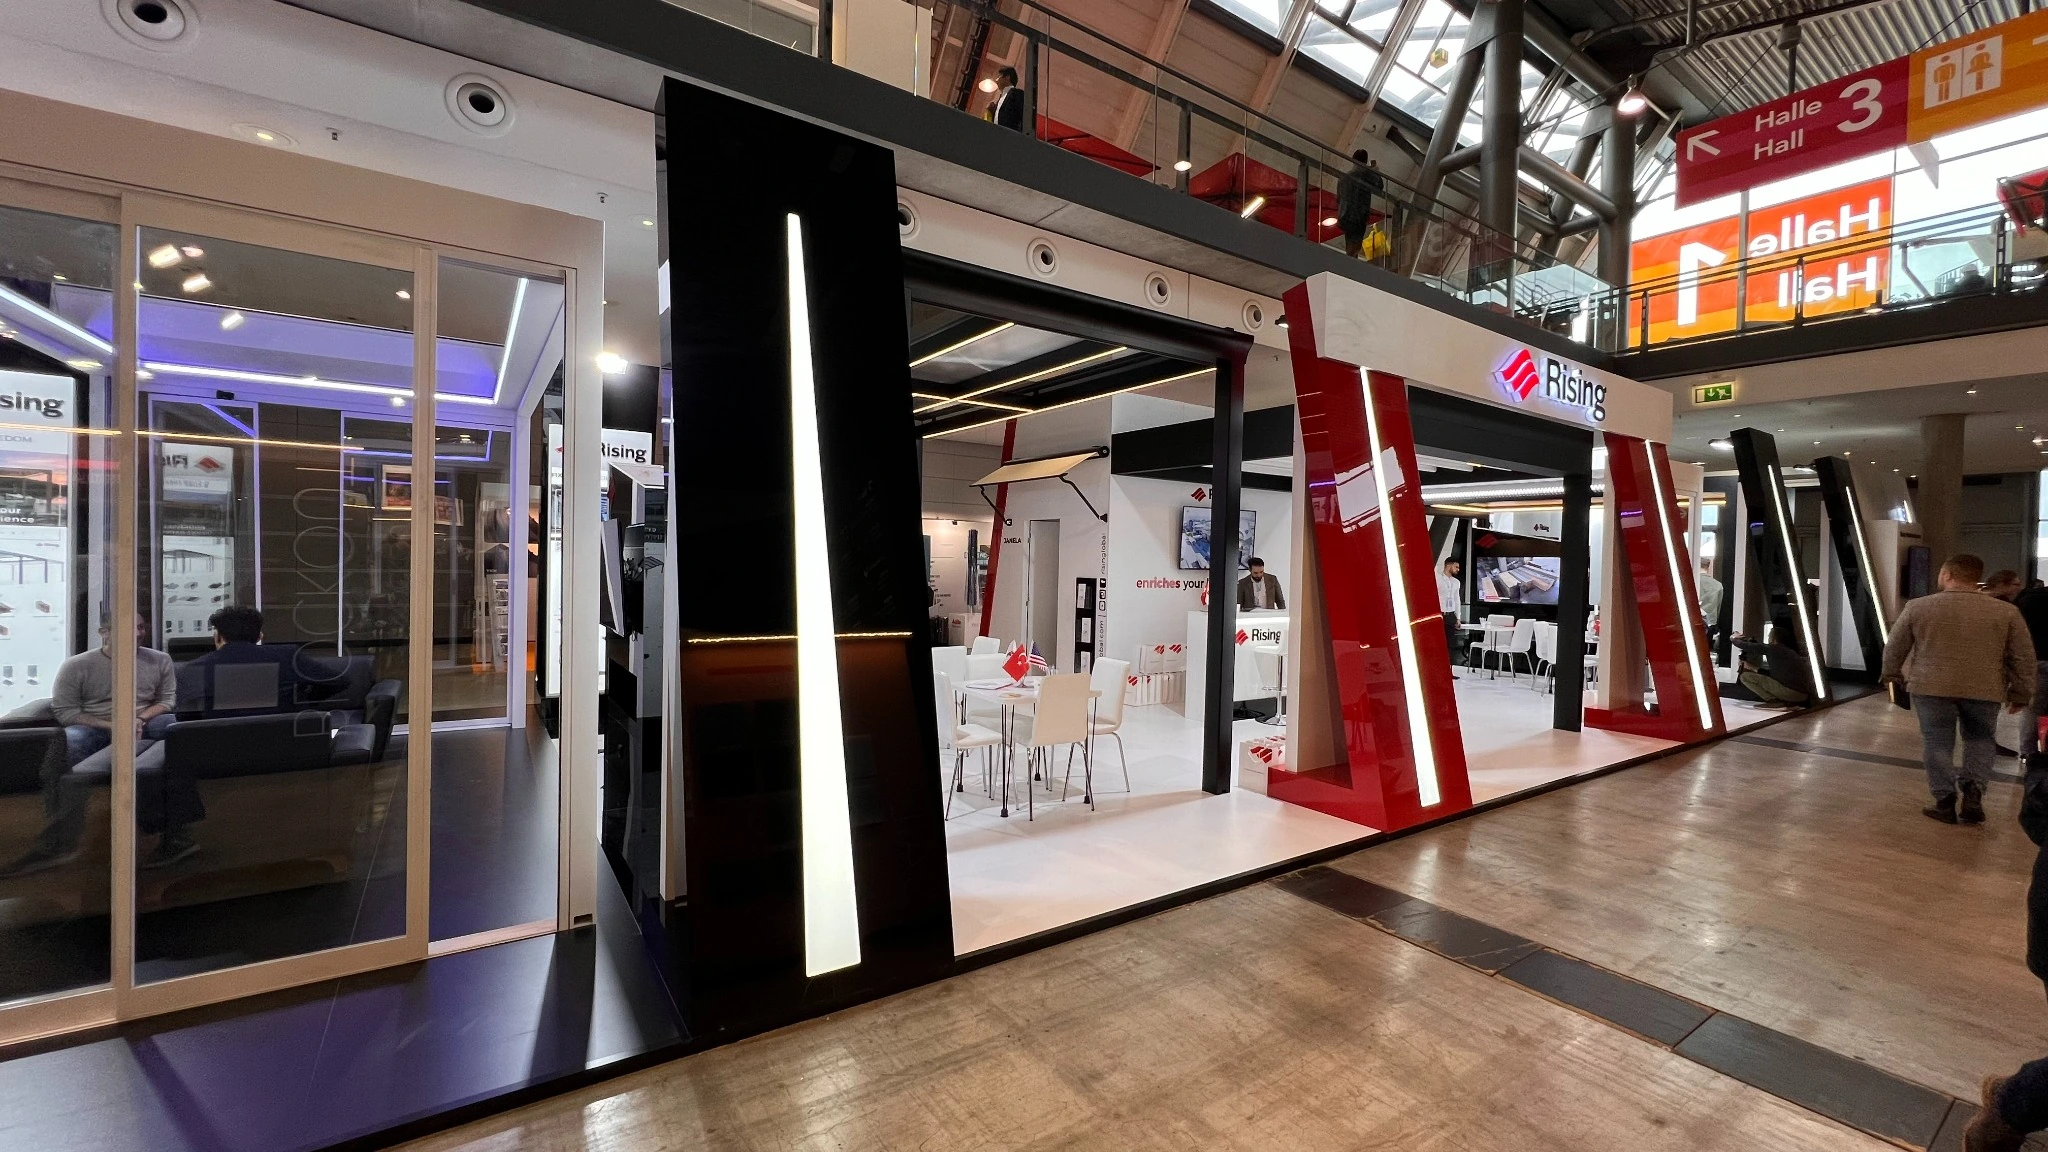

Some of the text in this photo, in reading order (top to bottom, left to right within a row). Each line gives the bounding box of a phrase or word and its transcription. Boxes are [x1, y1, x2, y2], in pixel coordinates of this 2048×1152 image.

[1754, 99, 1823, 133] Halle
[1836, 78, 1883, 133] 3
[1754, 129, 1804, 161] Hall
[1546, 358, 1607, 421] Rising
[1136, 577, 1180, 589] enriches
[1183, 580, 1205, 591] your
[1251, 628, 1282, 645] Rising
